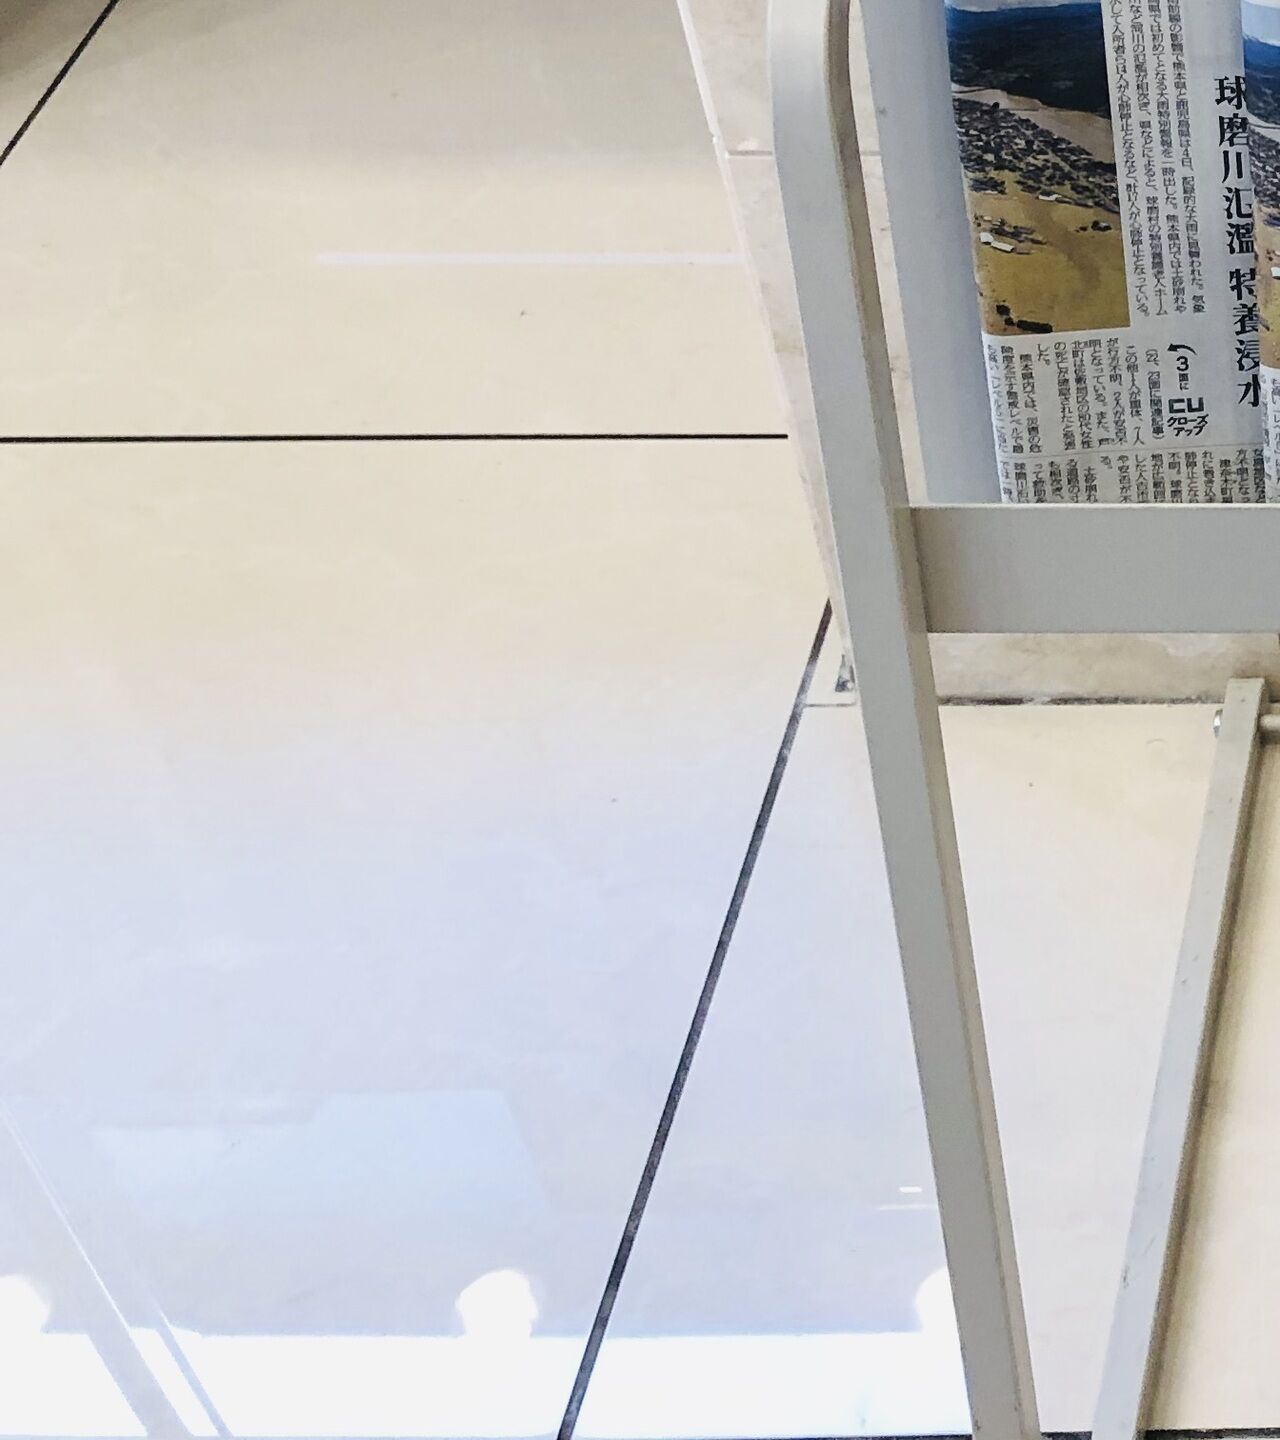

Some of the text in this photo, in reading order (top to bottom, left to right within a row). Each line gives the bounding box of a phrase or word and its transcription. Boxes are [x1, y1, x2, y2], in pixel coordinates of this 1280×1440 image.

[1166, 414, 1209, 430] クローズ
[1172, 425, 1207, 438] アップ
